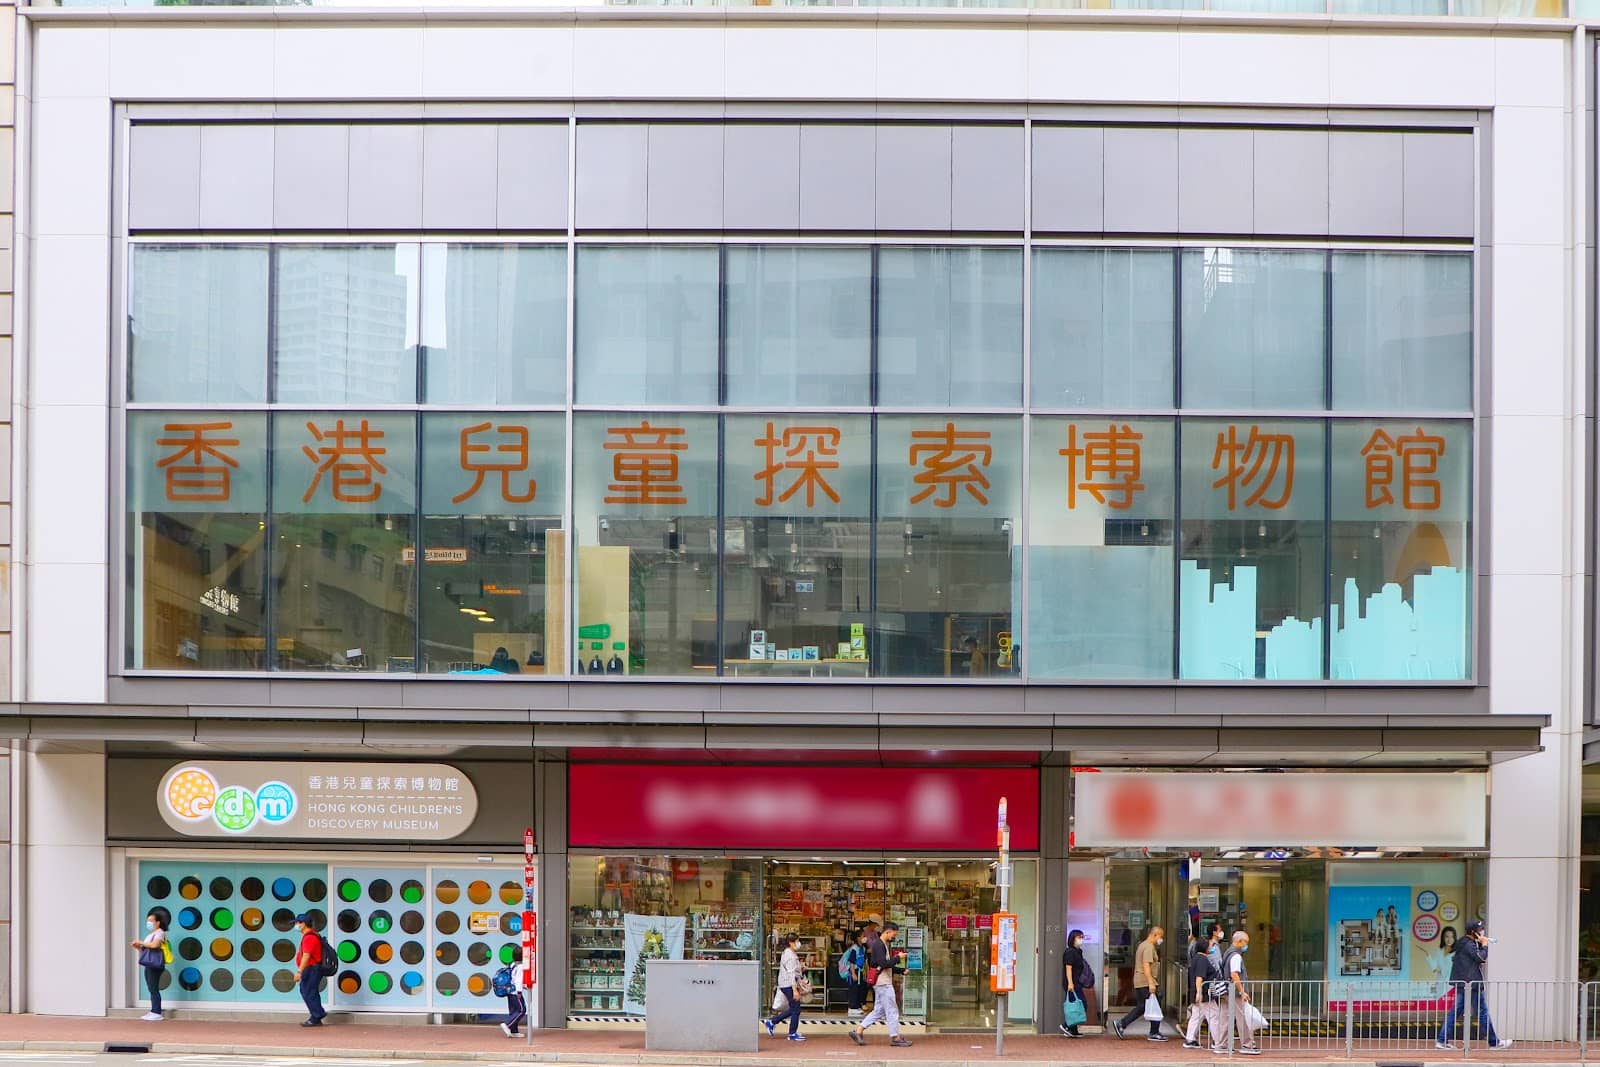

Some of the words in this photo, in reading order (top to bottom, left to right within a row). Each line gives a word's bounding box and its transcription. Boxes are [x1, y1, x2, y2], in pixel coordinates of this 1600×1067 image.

[156, 419, 1445, 510] 香港兒童探索博物館
[308, 775, 459, 791] 香港兒童探索博物館
[308, 803, 346, 814] HONG
[350, 804, 385, 814] KONG
[389, 804, 463, 815] CHILDREN'S
[308, 818, 378, 829] DISCOVERY
[383, 819, 439, 830] MUSEUM
